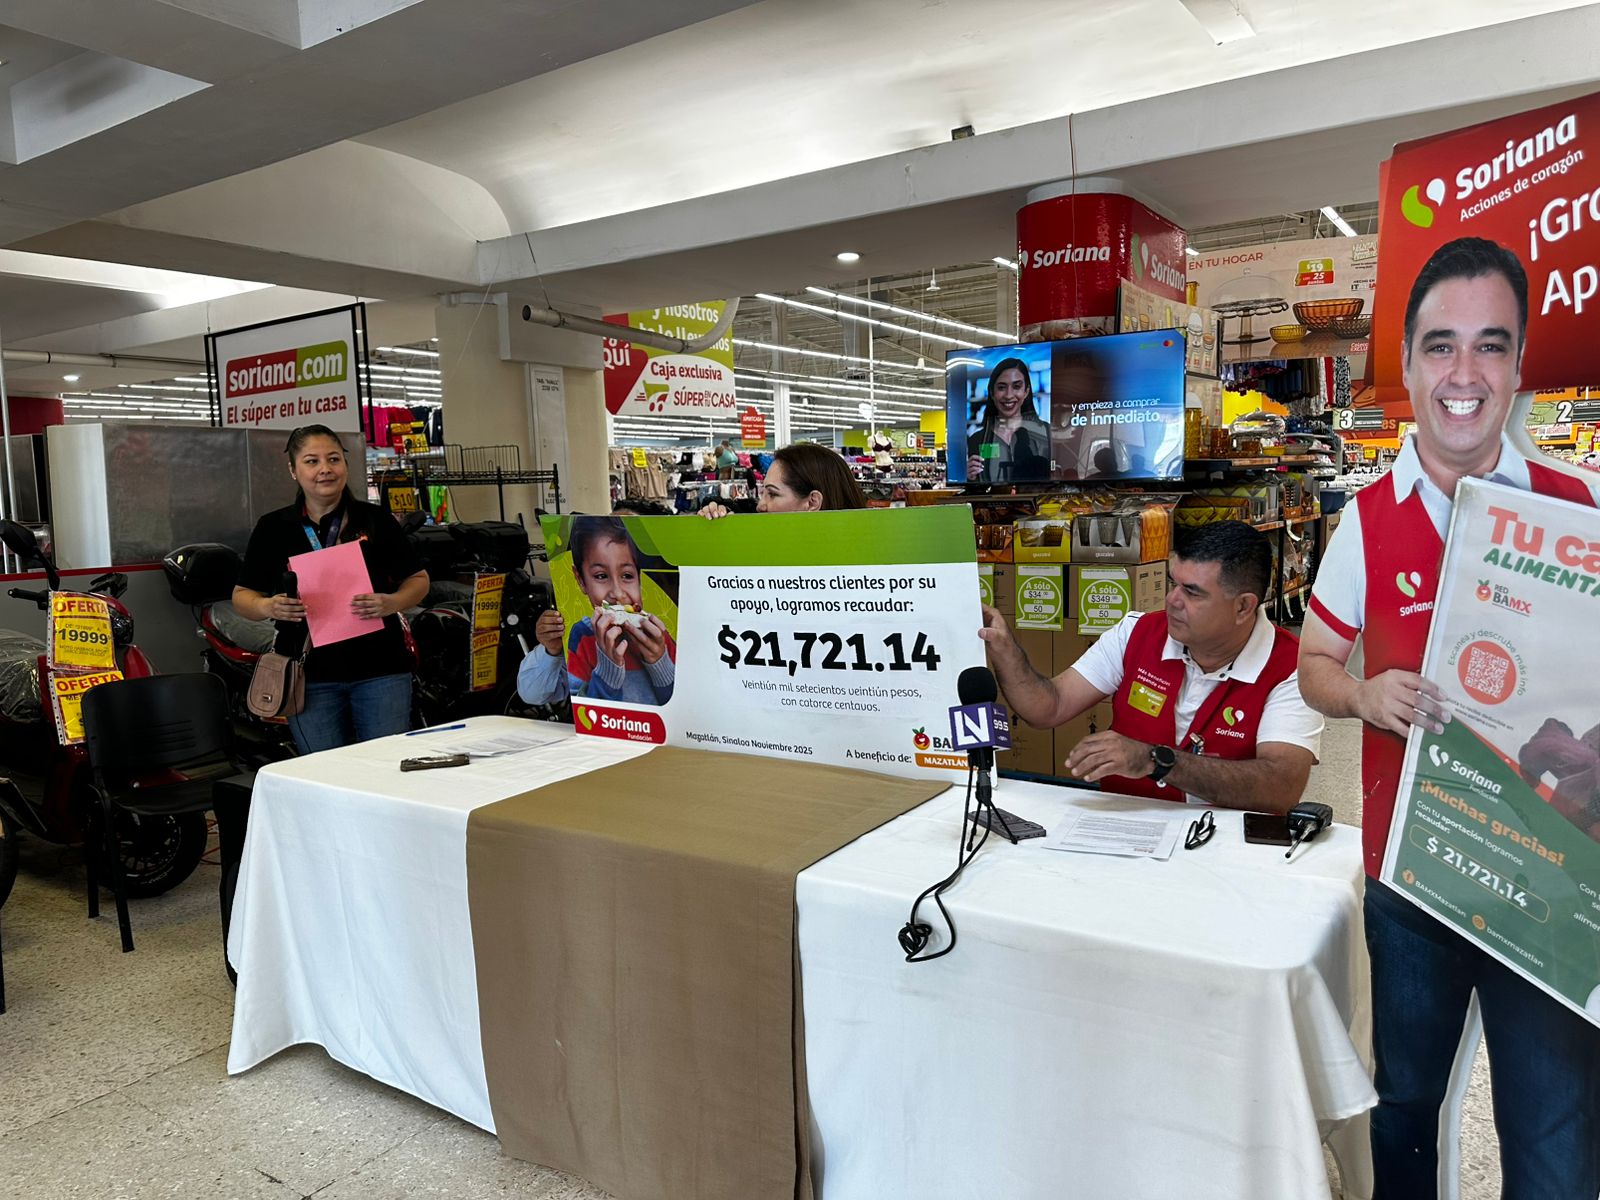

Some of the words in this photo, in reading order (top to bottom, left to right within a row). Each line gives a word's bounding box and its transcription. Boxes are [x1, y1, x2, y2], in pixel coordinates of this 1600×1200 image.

[1455, 114, 1577, 200] Soriana
[1460, 187, 1512, 222] Acciones
[1514, 176, 1529, 194] de
[1531, 149, 1584, 185] corazón
[1032, 243, 1111, 269] Soriana
[1188, 260, 1204, 271] EN
[1205, 258, 1220, 268] TU
[1223, 252, 1263, 266] HOGAR
[1151, 254, 1186, 292] Soriana
[665, 303, 719, 323] nosotros
[229, 351, 343, 393] soriana.com
[651, 361, 677, 381] Caja
[679, 365, 723, 381] exclusiva
[673, 386, 704, 406] SÚPER
[711, 392, 736, 409] CASA
[1071, 403, 1077, 414] y
[1078, 401, 1113, 412] empieza
[1122, 397, 1160, 410] comprar
[227, 405, 238, 424] El
[242, 401, 277, 426] súper
[280, 402, 295, 417] en
[299, 396, 311, 415] tu
[316, 395, 347, 413] casa
[1071, 413, 1088, 427] de
[1090, 410, 1160, 426] inmediato
[1340, 409, 1354, 429] 3
[1557, 401, 1572, 423] 2
[907, 432, 916, 448] 6
[1488, 505, 1545, 556] Tu
[707, 576, 754, 590] Gracias
[757, 579, 765, 590] a
[769, 576, 826, 590] nuestros
[829, 576, 885, 590] clientes
[889, 577, 915, 593] por
[918, 577, 936, 590] su
[1495, 584, 1509, 594] RED
[54, 600, 107, 614] OFERTA
[730, 599, 773, 615] apoyo,
[776, 598, 841, 615] logramos
[844, 598, 914, 612] recaudar:
[1400, 601, 1434, 617] Soriana
[1493, 592, 1532, 613] BAMX
[717, 624, 941, 676] $21,721.14
[1448, 634, 1471, 666] Escanea
[1517, 678, 1528, 696] info
[56, 674, 120, 691] OFERTA
[742, 679, 777, 692] Veintiún
[779, 682, 794, 692] mil
[796, 684, 846, 696] setecientos
[848, 686, 888, 697] veintiún
[890, 687, 922, 699] pesos,
[781, 697, 797, 706] con
[799, 698, 832, 709] catorce
[834, 700, 881, 712] centavos.
[601, 714, 651, 733] Soriana
[1215, 727, 1245, 739] Soriana
[627, 733, 653, 742] Fundación
[686, 731, 721, 744] Mazatlán,
[722, 735, 750, 747] Sinaloa
[751, 739, 793, 753] Noviembre
[794, 744, 813, 755] 2025
[846, 749, 853, 759] A
[854, 749, 896, 762] beneficio
[898, 752, 912, 763] de:
[1451, 760, 1502, 795] Soriana
[1415, 810, 1450, 834] recaudar:
[1420, 779, 1488, 824] ¡Muchas
[1491, 820, 1565, 867] gracias!
[1416, 800, 1431, 813] Con
[1432, 809, 1440, 818] tu
[1441, 815, 1484, 843] aportación
[1485, 838, 1524, 866] logramos
[1426, 836, 1439, 855] $
[1443, 846, 1528, 907] 21,721.14
[1579, 883, 1597, 898] Con
